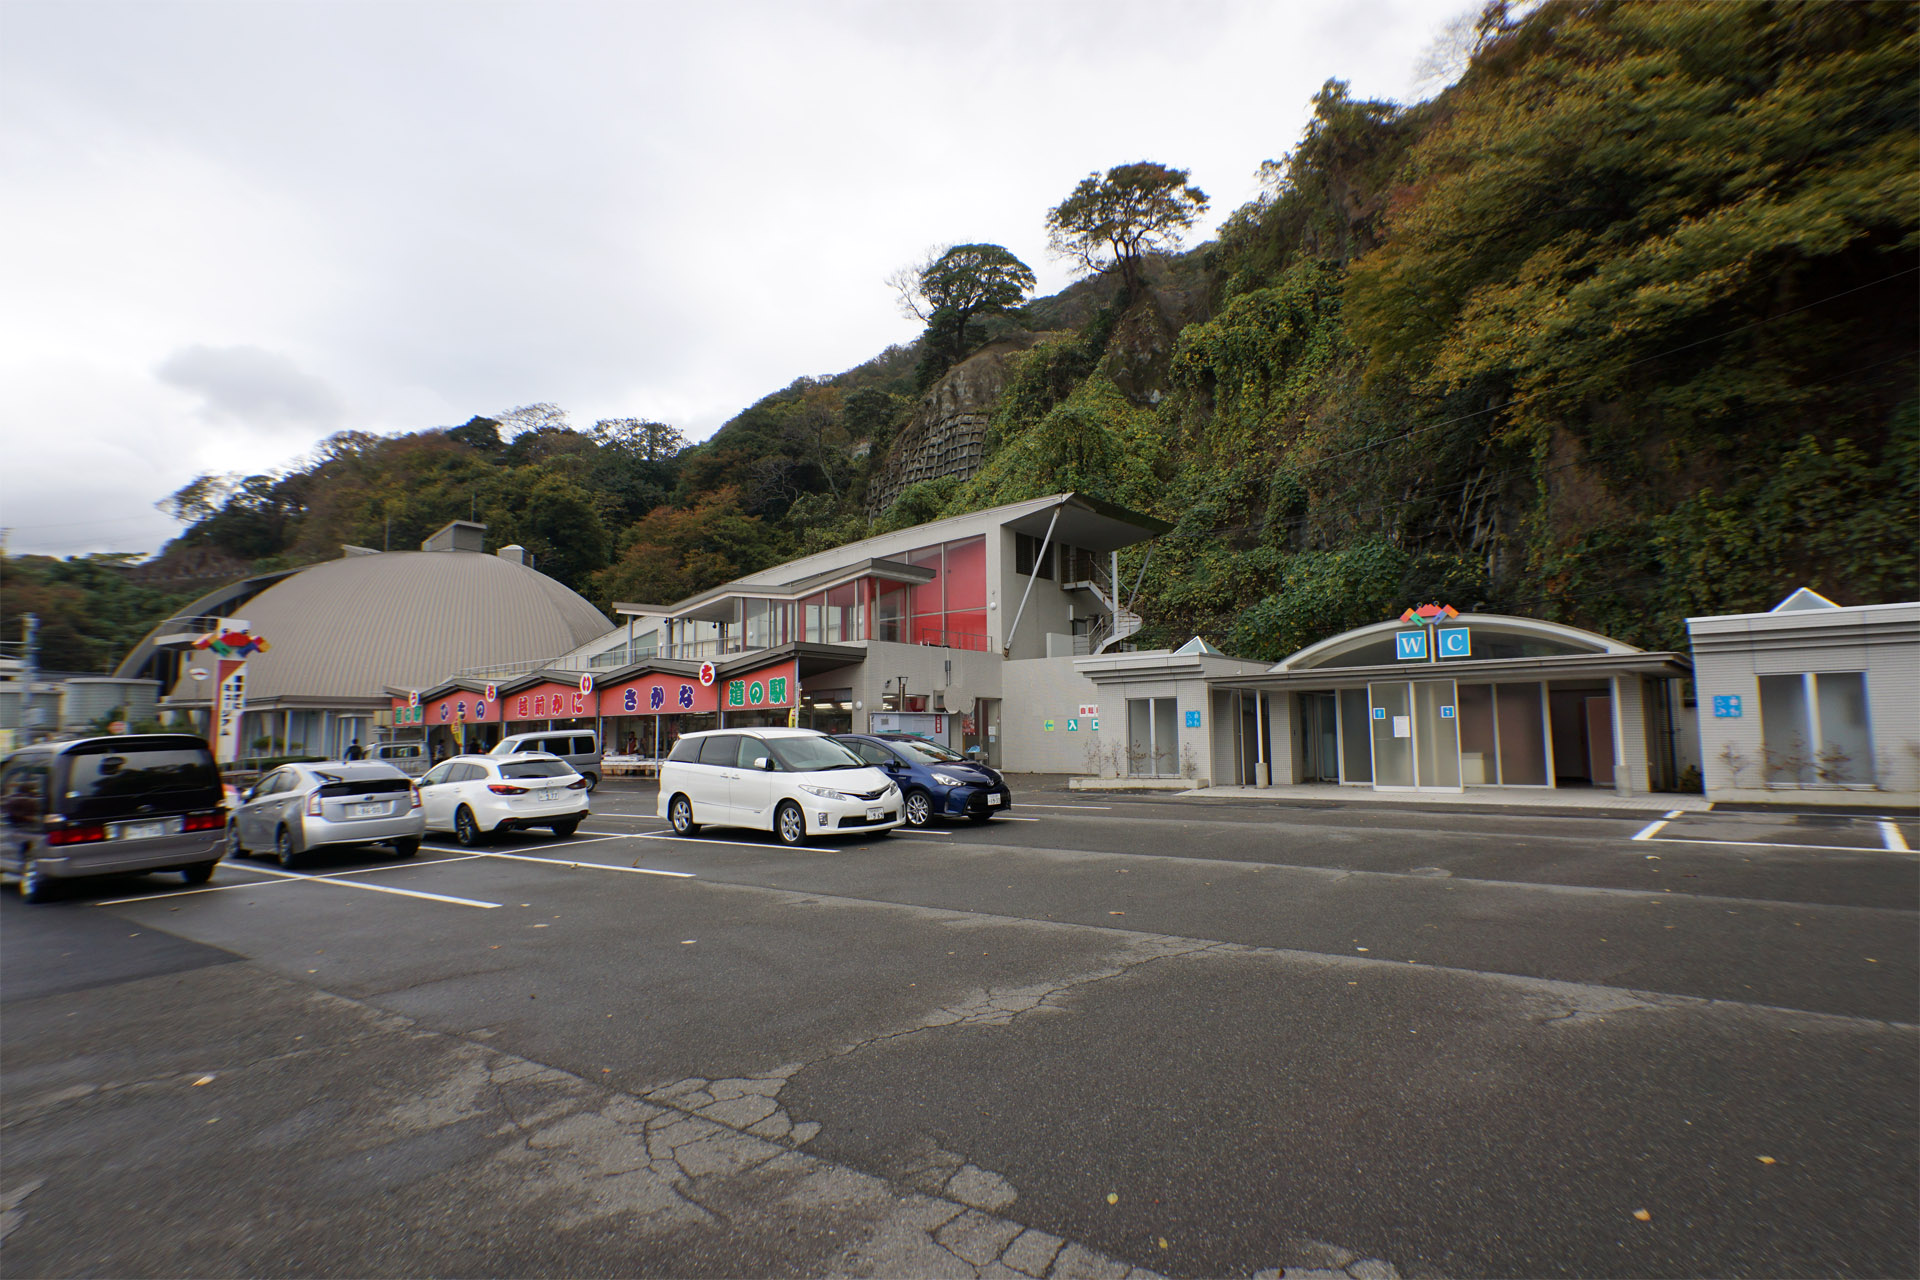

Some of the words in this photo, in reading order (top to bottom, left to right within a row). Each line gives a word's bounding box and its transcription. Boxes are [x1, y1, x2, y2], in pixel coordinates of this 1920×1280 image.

[701, 664, 713, 683] ち
[624, 684, 694, 712] さかな
[729, 676, 787, 707] 道の駅
